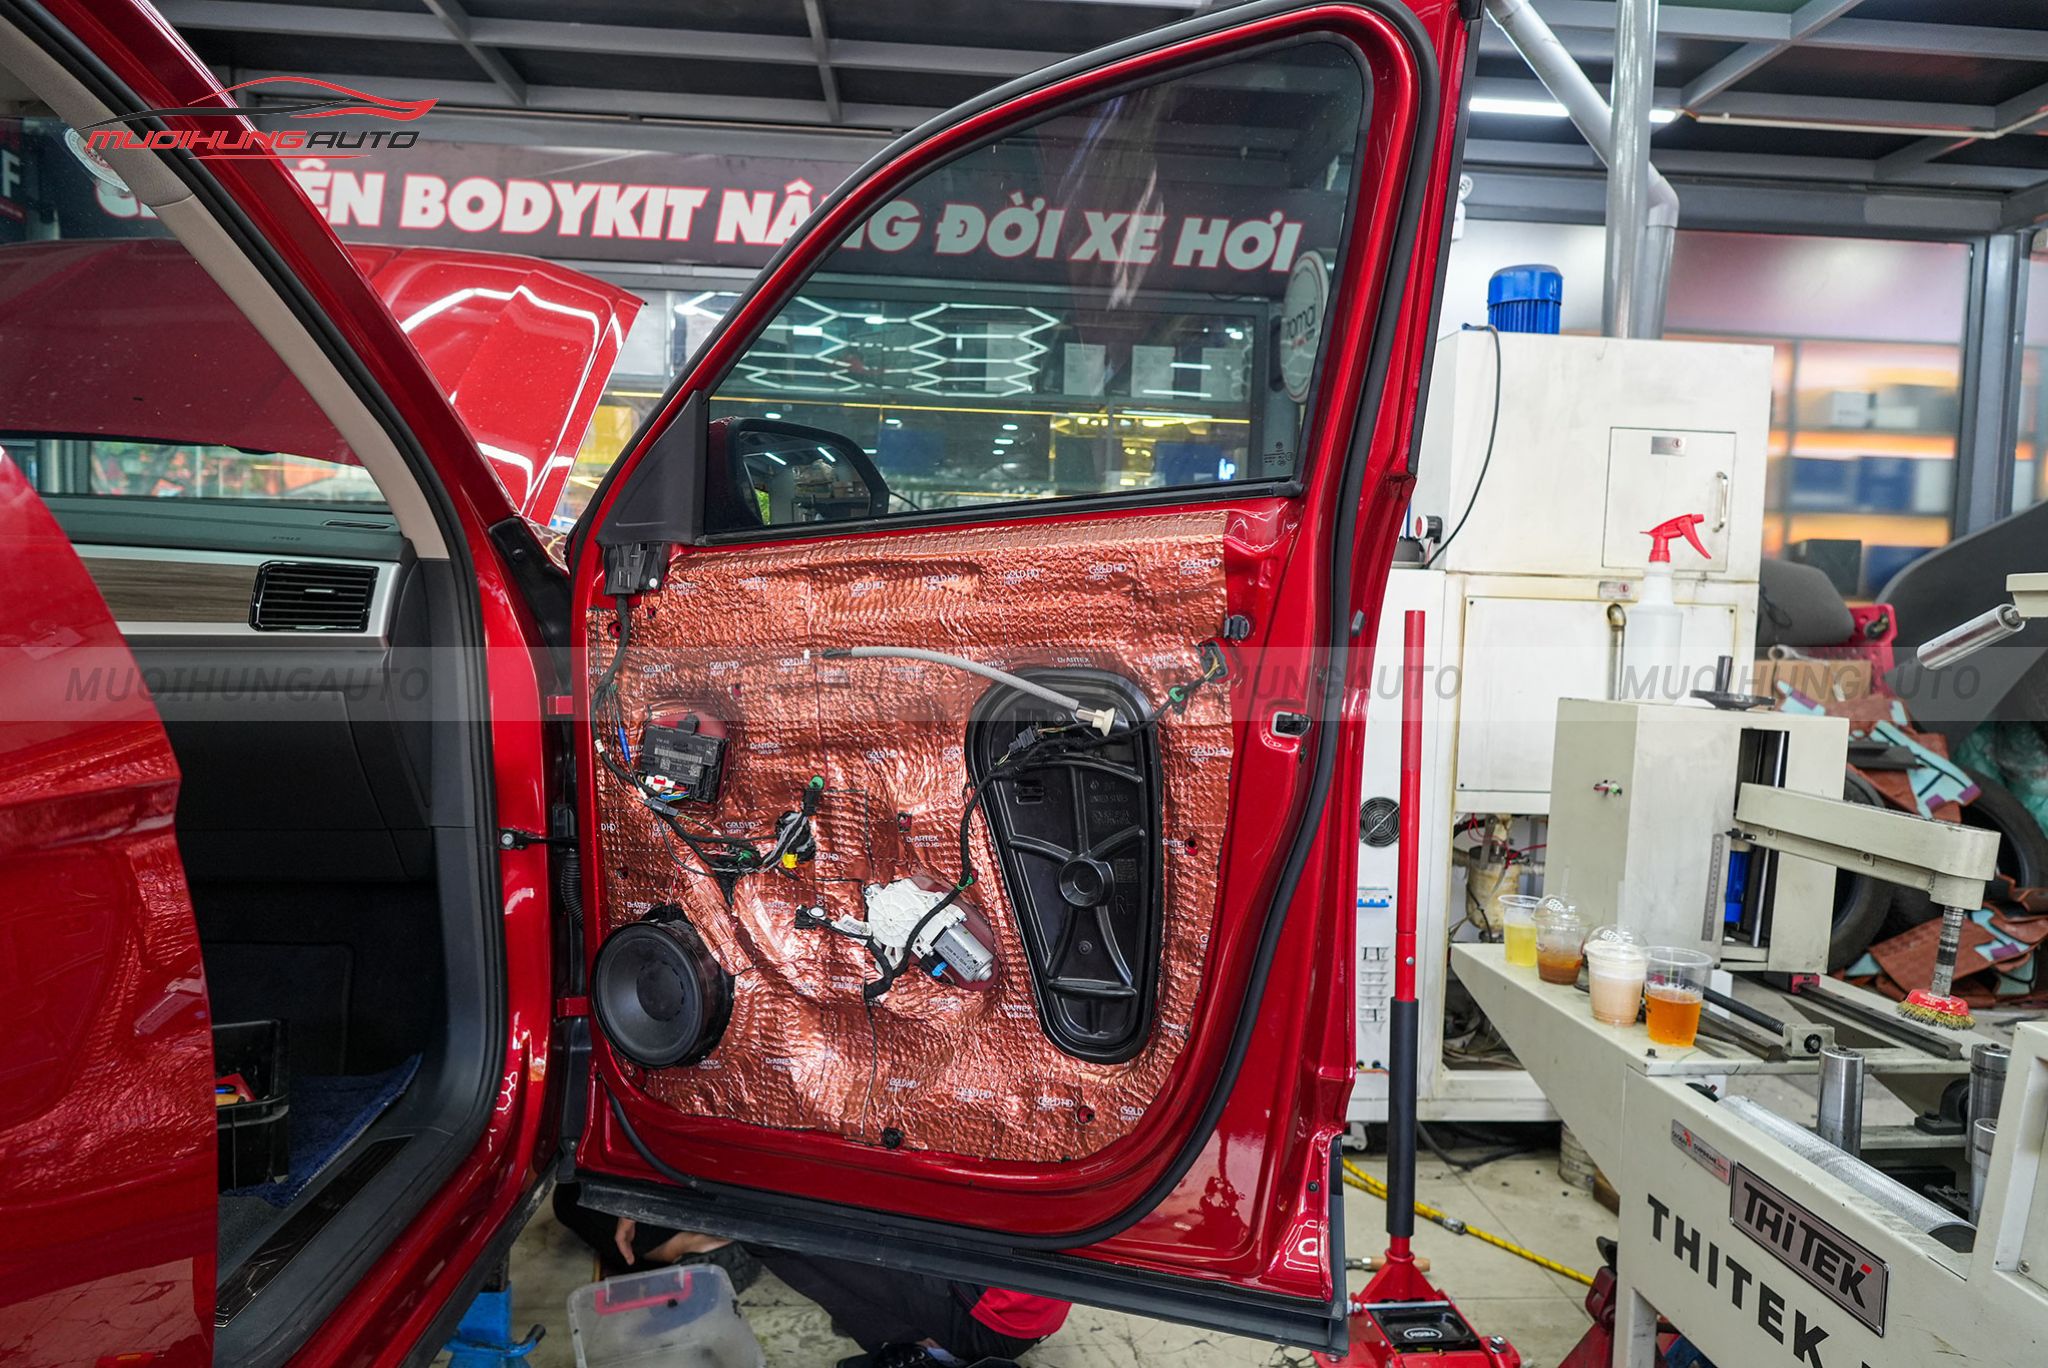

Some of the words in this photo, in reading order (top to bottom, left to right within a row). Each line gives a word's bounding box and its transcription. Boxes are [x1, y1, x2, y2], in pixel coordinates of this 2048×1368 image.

[400, 175, 708, 241] BODYKIT
[935, 191, 1066, 260] ĐỜI
[1070, 211, 1165, 265] XE
[1172, 211, 1302, 272] HƠI
[906, 835, 938, 843] DrARTEX
[1647, 1192, 1830, 1368] THITEK
